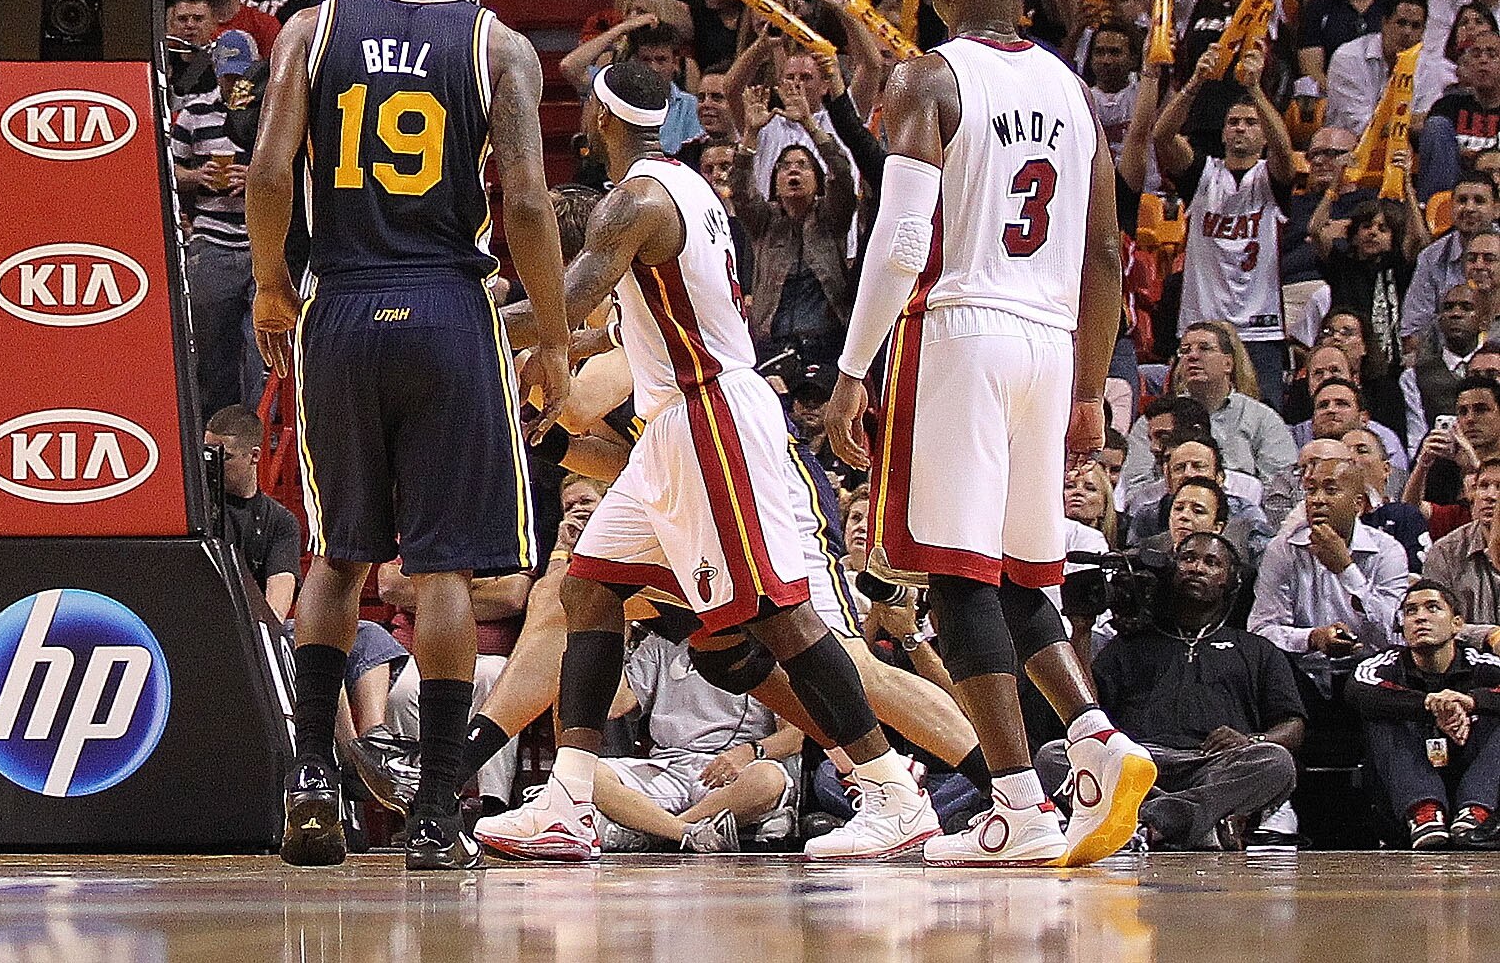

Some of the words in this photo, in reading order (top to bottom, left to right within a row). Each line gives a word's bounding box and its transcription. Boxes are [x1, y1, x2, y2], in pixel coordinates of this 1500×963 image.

[361, 38, 431, 78] BELL
[25, 106, 115, 143] KIA
[334, 83, 447, 196] 19
[992, 110, 1065, 151] WADE
[1002, 158, 1058, 257] 3
[1240, 240, 1260, 273] 3
[19, 263, 123, 306] KIA
[373, 307, 411, 322] UTAH
[10, 432, 130, 481] KIA
